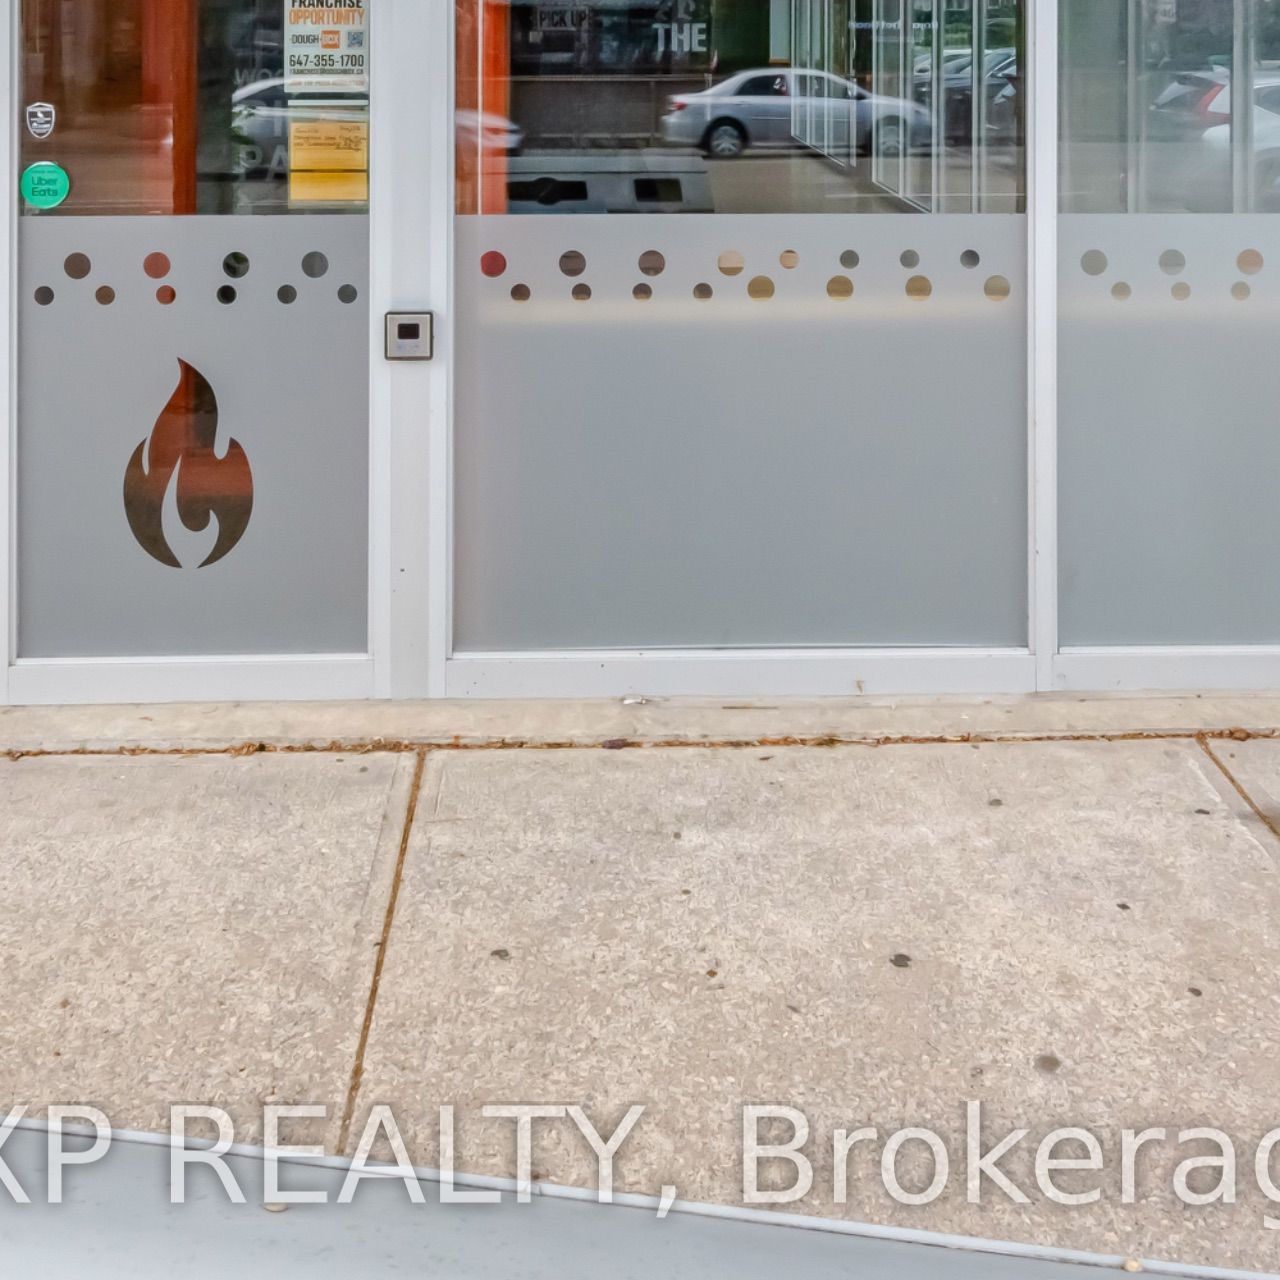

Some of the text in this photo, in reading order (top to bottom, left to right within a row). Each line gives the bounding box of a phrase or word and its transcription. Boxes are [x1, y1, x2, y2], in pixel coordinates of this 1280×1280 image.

[289, 9, 365, 24] OPPORTUNITY
[291, 34, 320, 44] DOUGH
[652, 22, 707, 52] THE
[289, 54, 364, 67] 647-355-1700
[31, 176, 58, 186] Uber
[31, 187, 58, 196] Eats
